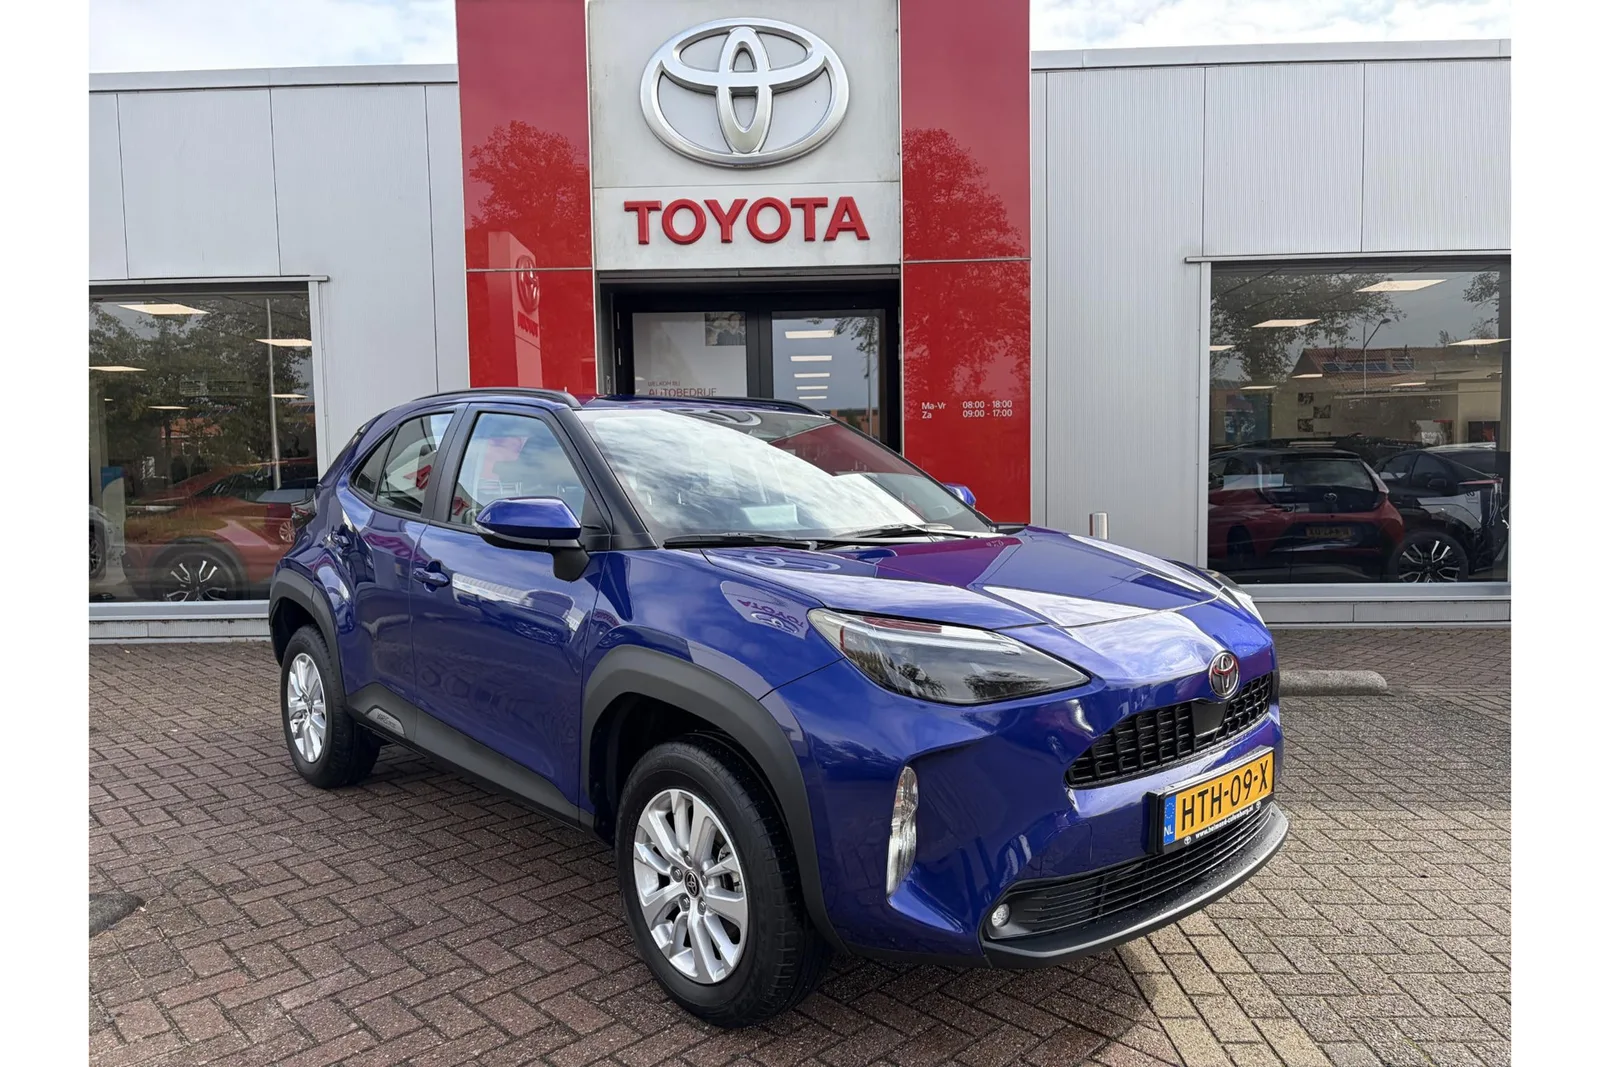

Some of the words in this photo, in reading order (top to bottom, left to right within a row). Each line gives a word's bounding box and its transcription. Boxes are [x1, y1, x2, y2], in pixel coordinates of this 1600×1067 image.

[624, 196, 870, 245] TOYOTA
[648, 387, 717, 397] AUTOBEDRIJF
[921, 402, 946, 410] Ma-Vr
[962, 400, 985, 409] 08:00
[992, 399, 1013, 408] 18:00
[922, 411, 932, 419] Za
[962, 409, 985, 418] 09:00
[992, 409, 1013, 417] 17:00
[1181, 760, 1268, 831] HTH-09-X
[1163, 824, 1174, 837] NL
